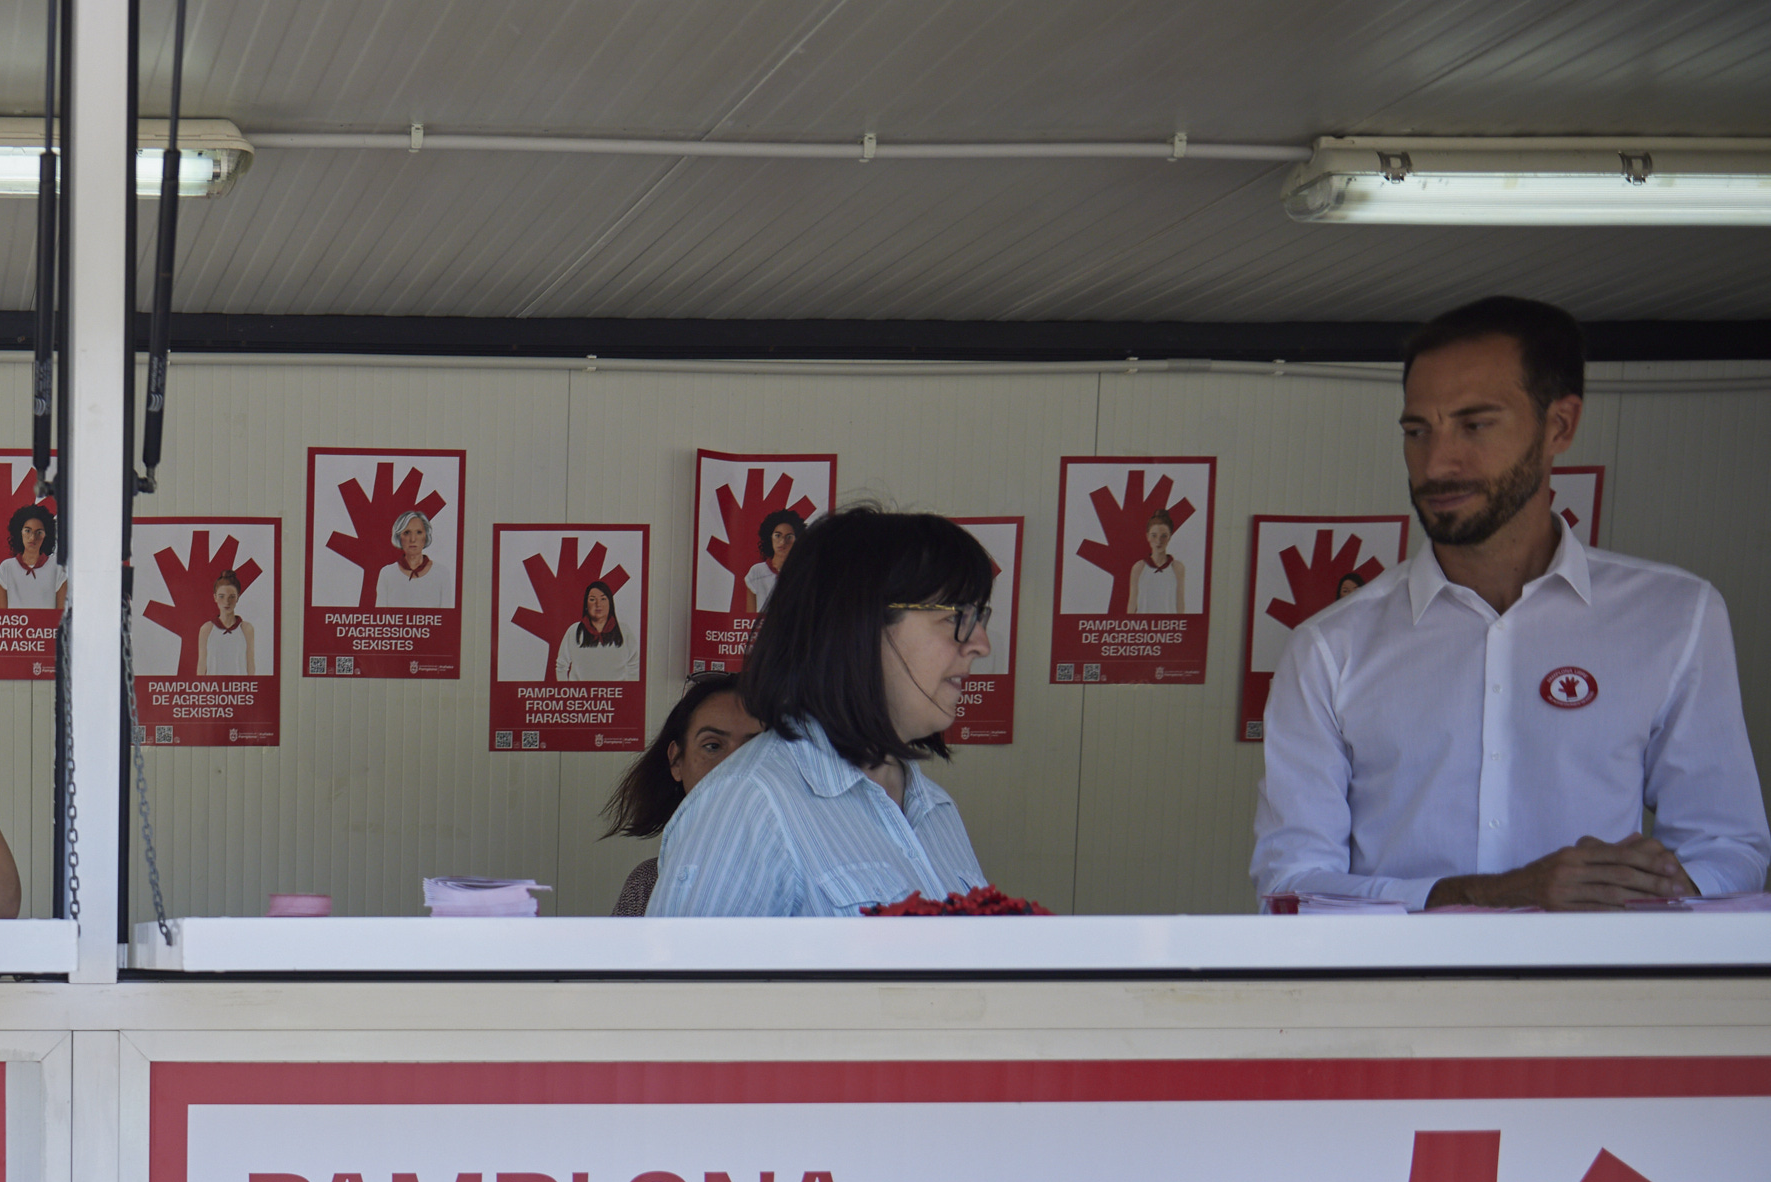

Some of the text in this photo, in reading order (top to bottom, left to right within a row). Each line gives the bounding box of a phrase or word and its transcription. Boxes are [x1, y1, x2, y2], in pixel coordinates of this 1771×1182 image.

[324, 613, 443, 626] PAMPELUNE LIBRE
[1078, 619, 1188, 631] PAMPLONA LIBRE
[1081, 632, 1183, 644] DE AGRESIONES
[10, 640, 46, 652] ASKE
[352, 639, 414, 651] SEXISTES
[1100, 645, 1162, 657] SEXISTAS
[148, 681, 259, 693] PAMPLONA LIBRE
[517, 687, 624, 699] PAMPLONA FREE
[152, 694, 254, 706] DE AGRESIONES
[525, 700, 616, 711] FROM SEXUAL
[172, 707, 234, 719] SEXISTAS
[525, 712, 615, 724] HARASSMENT
